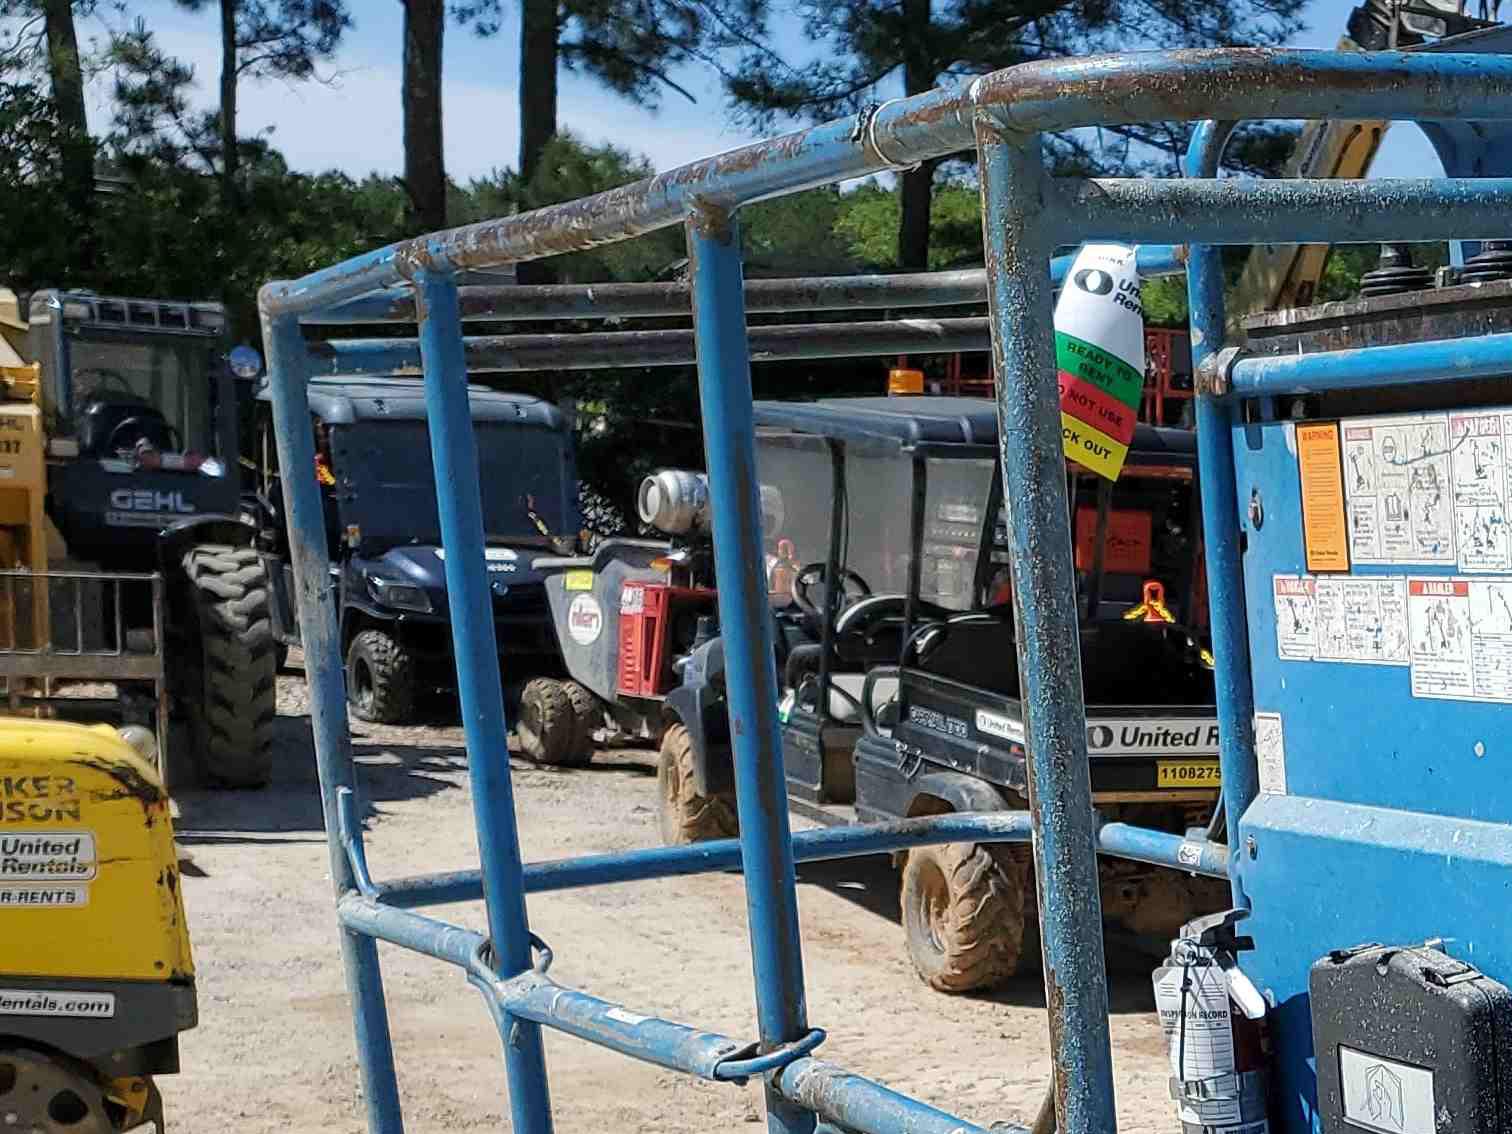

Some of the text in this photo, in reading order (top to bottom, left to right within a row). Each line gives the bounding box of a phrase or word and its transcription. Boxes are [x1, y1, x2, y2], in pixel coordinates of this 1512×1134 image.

[1062, 428, 1112, 460] CK OUT
[111, 488, 196, 513] GEHL
[1120, 726, 1201, 747] United
[0, 775, 75, 799] KER
[0, 801, 80, 822] SON
[1, 838, 80, 856] United
[0, 996, 110, 1014] entals.com
